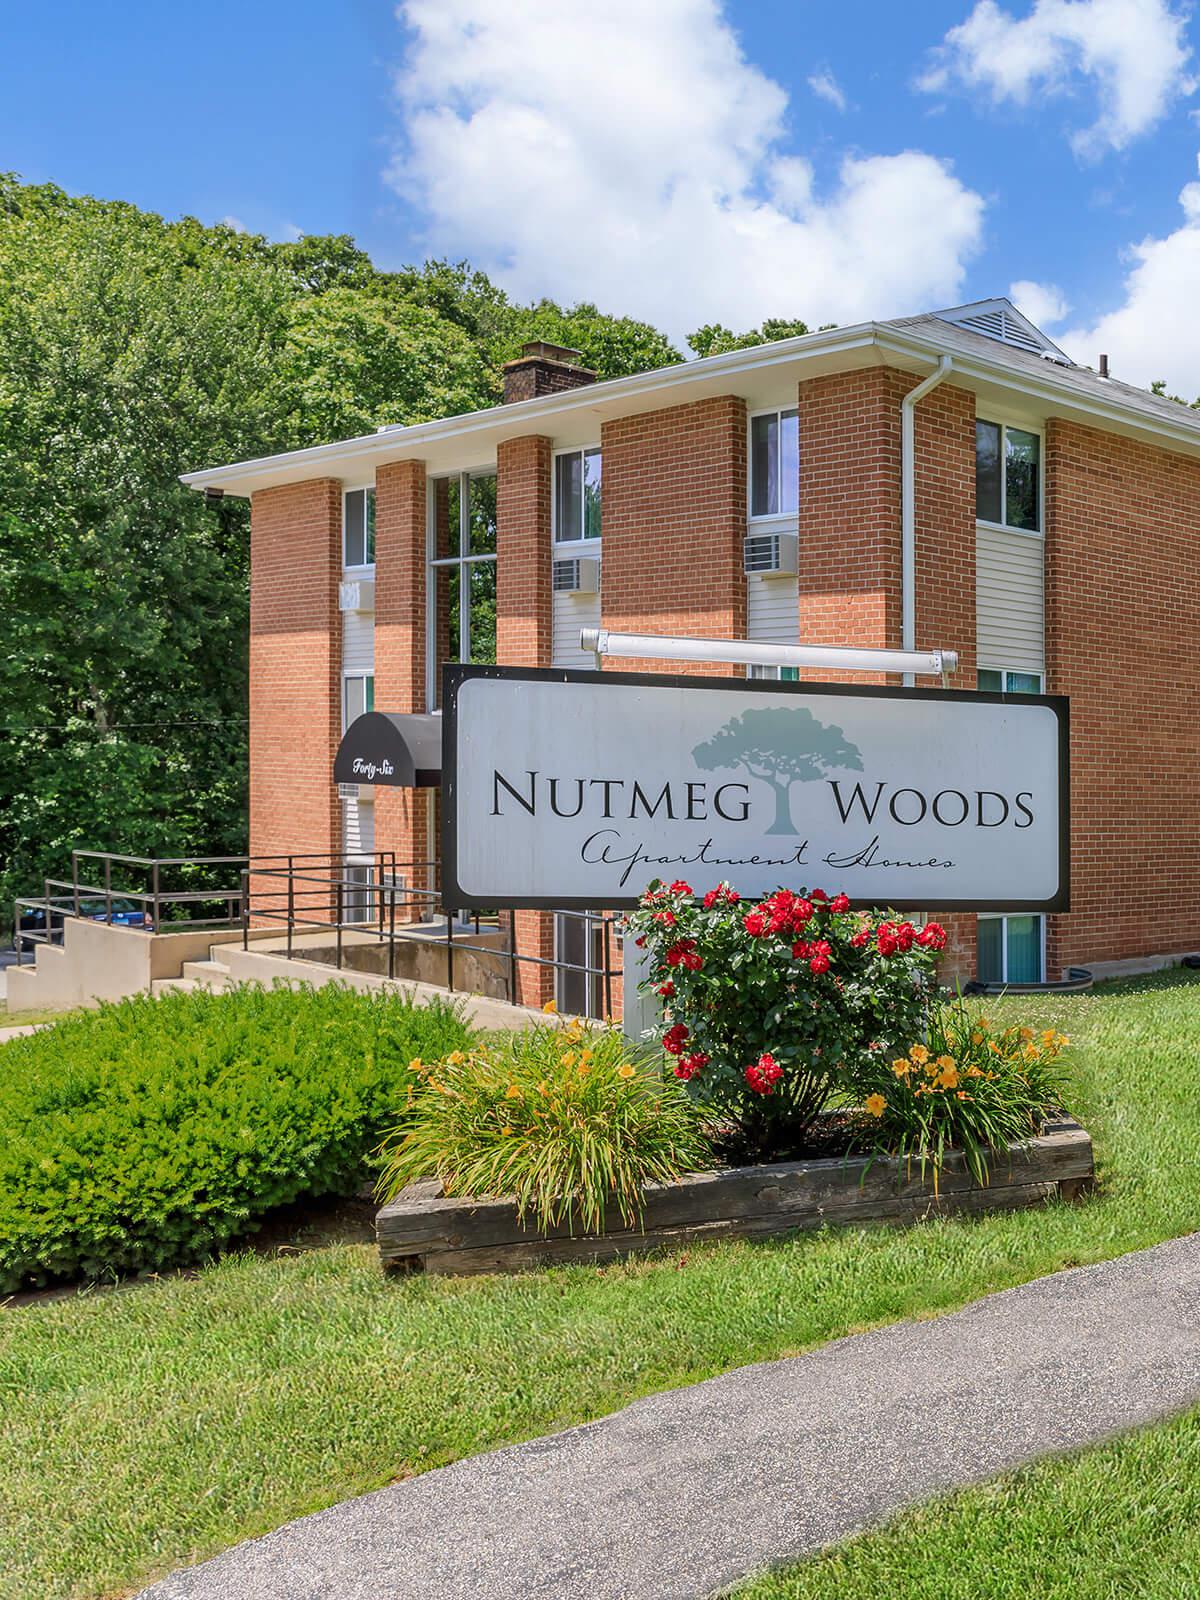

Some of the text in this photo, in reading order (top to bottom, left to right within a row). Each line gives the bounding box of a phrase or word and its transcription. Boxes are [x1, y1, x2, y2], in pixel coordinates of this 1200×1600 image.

[352, 757, 395, 780] Forty-Six
[581, 829, 956, 887] Apartment Homes
